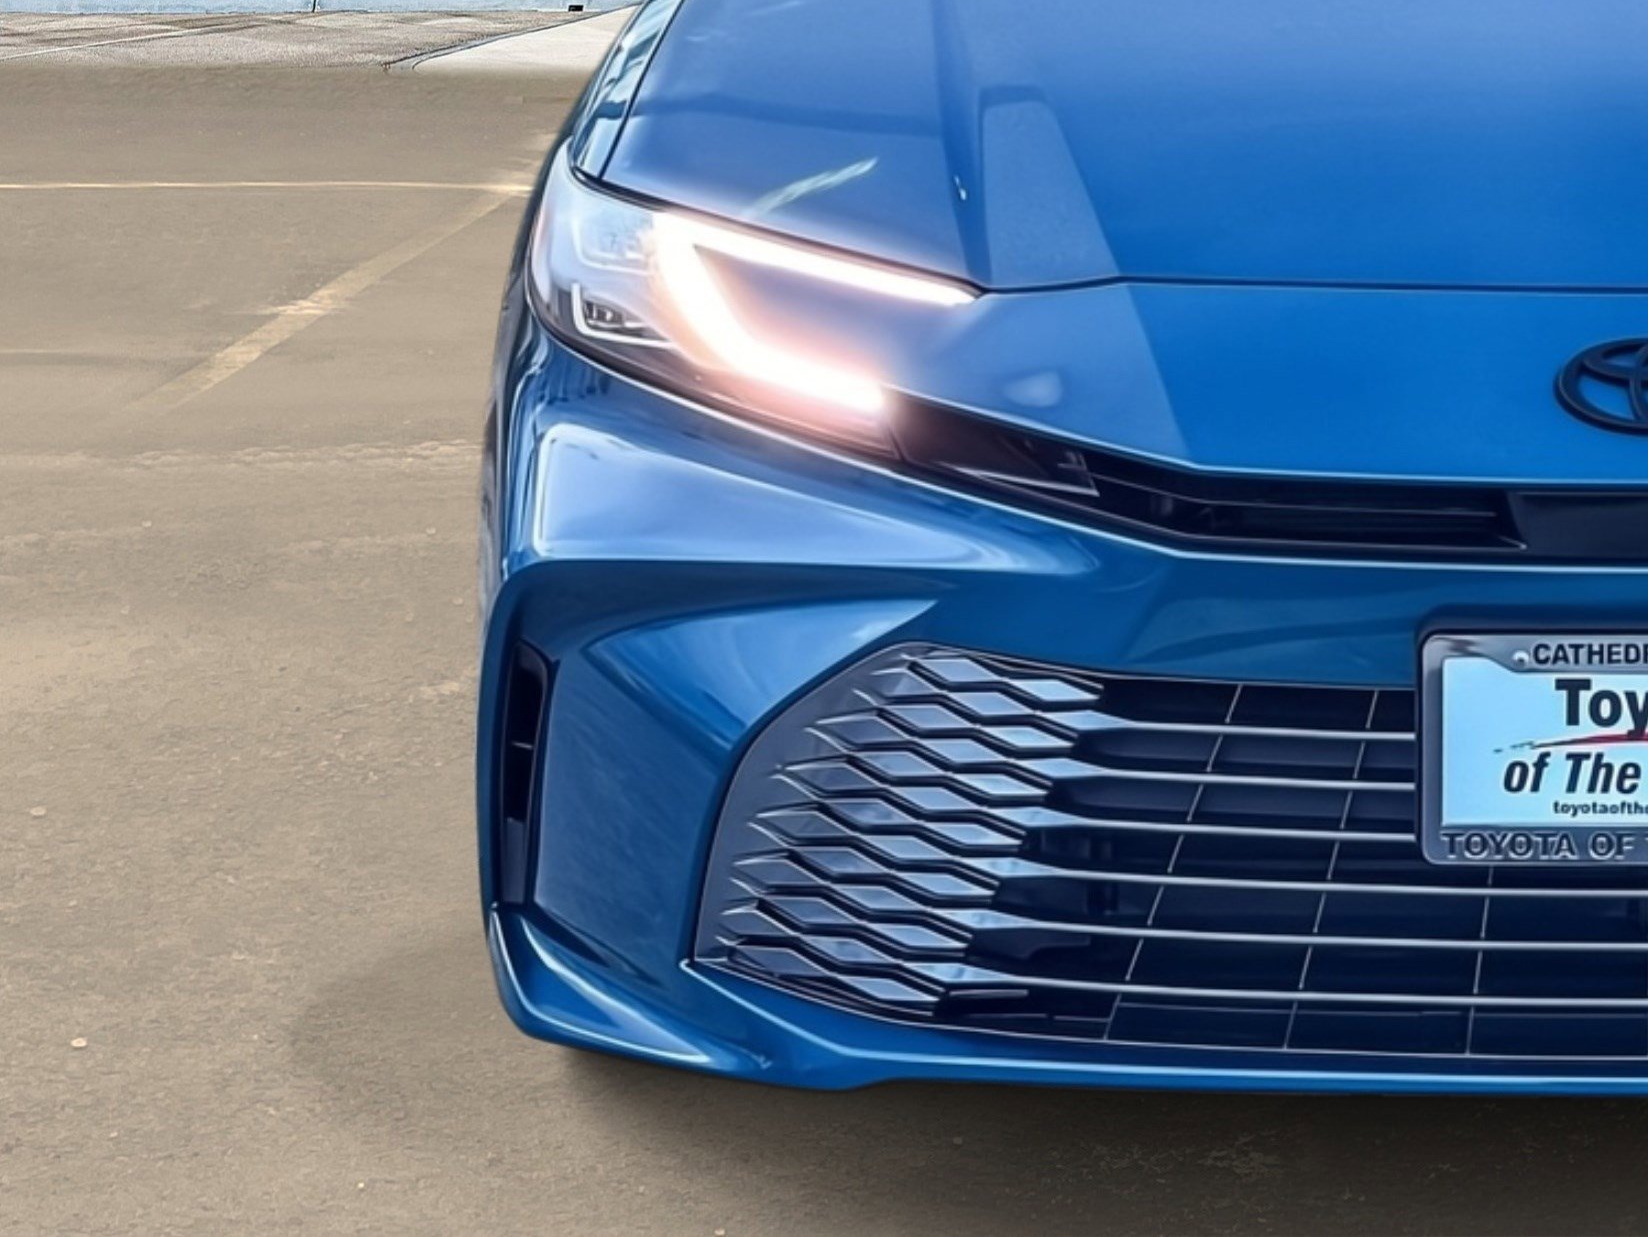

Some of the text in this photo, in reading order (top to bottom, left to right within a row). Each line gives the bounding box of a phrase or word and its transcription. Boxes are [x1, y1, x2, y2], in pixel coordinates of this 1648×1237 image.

[1503, 751, 1551, 794] of
[1565, 752, 1642, 794] The
[1440, 831, 1579, 860] TOYOTA
[1588, 831, 1635, 860] OF
